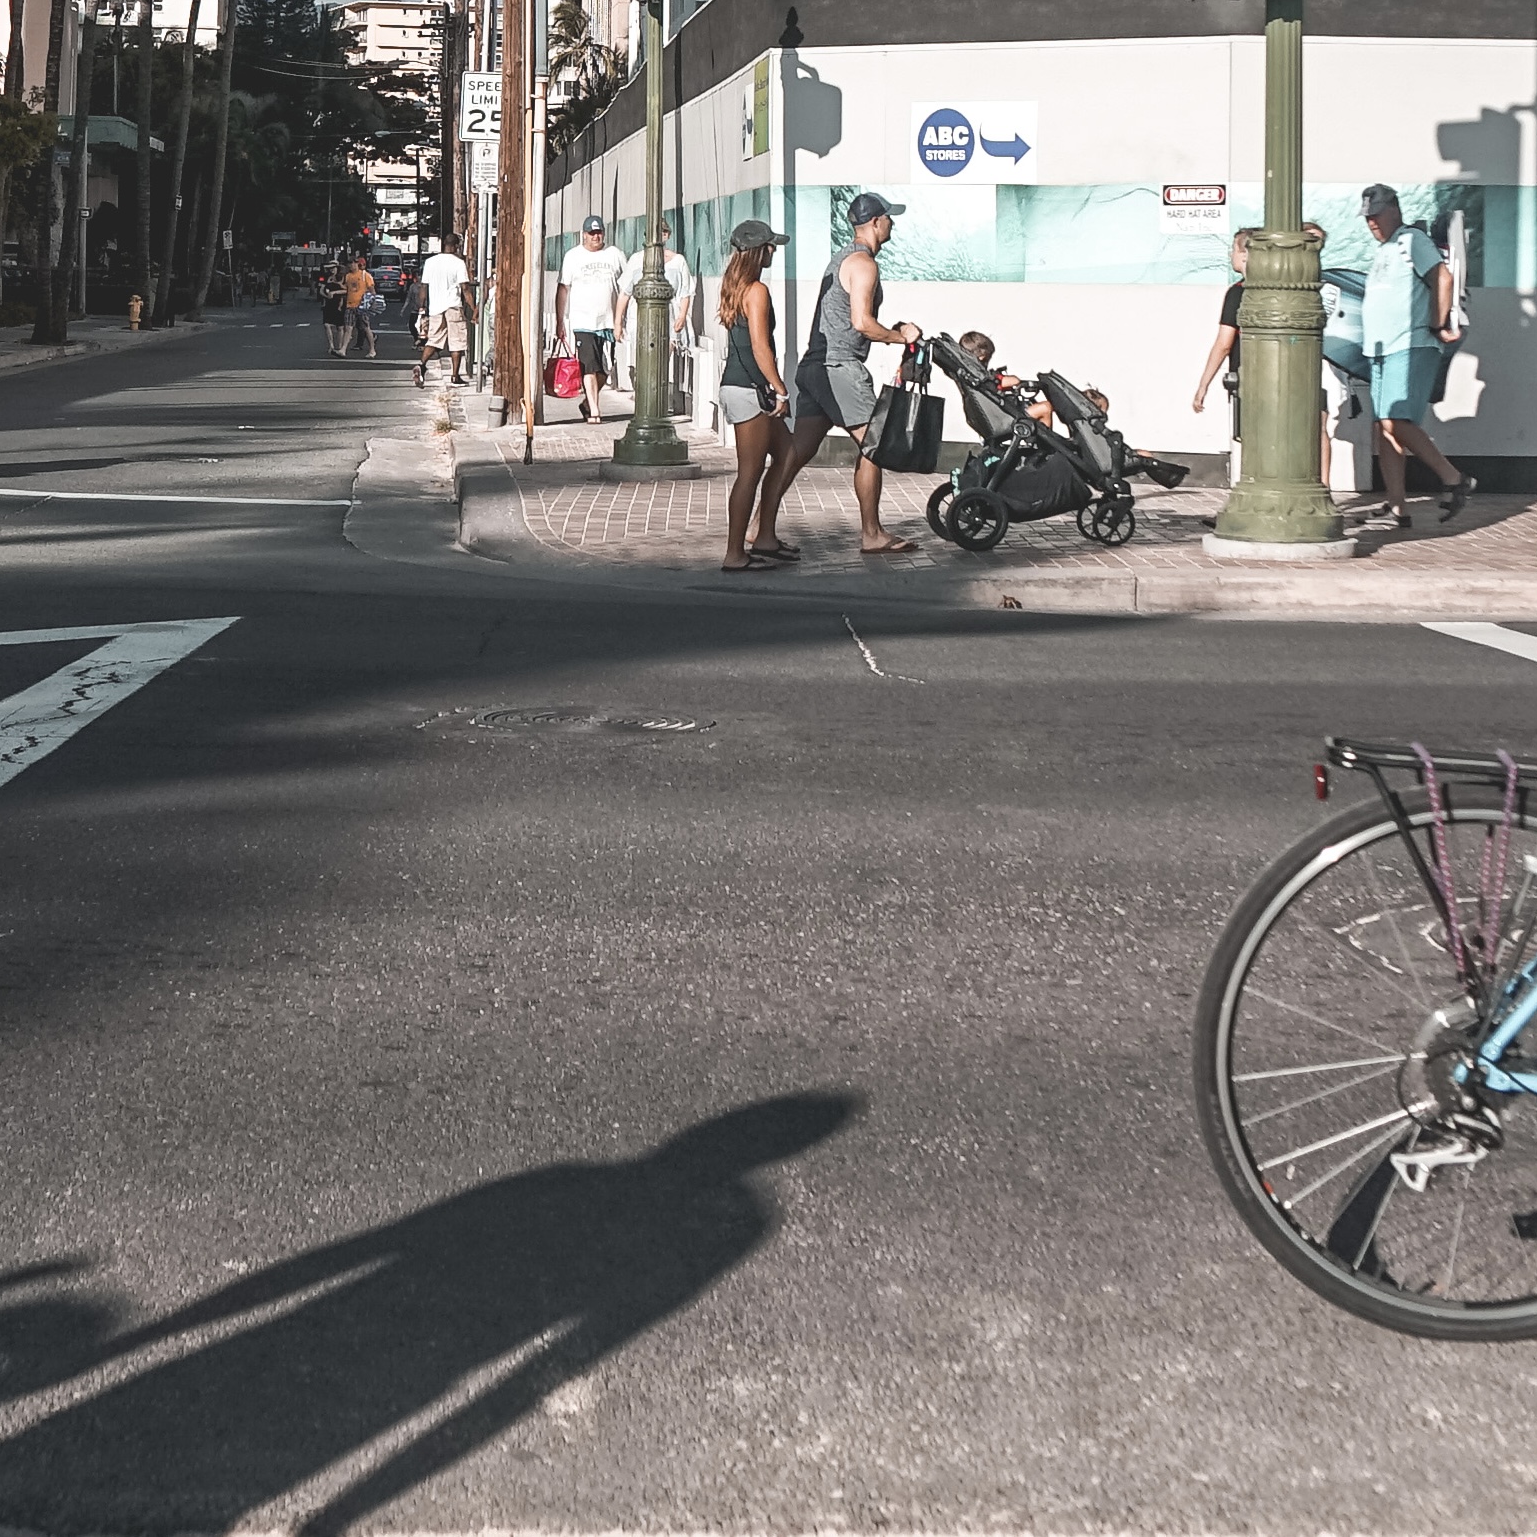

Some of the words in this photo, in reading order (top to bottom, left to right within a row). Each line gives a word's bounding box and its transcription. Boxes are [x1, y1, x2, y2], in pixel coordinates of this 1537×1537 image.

[468, 80, 502, 92] SPEE
[471, 95, 502, 105] LIMI
[922, 125, 969, 146] ABC
[925, 149, 966, 161] STORES
[1169, 188, 1220, 202] DANGER
[1167, 209, 1185, 218] HARD
[1188, 209, 1201, 218] HAT
[1203, 209, 1221, 218] AREA
